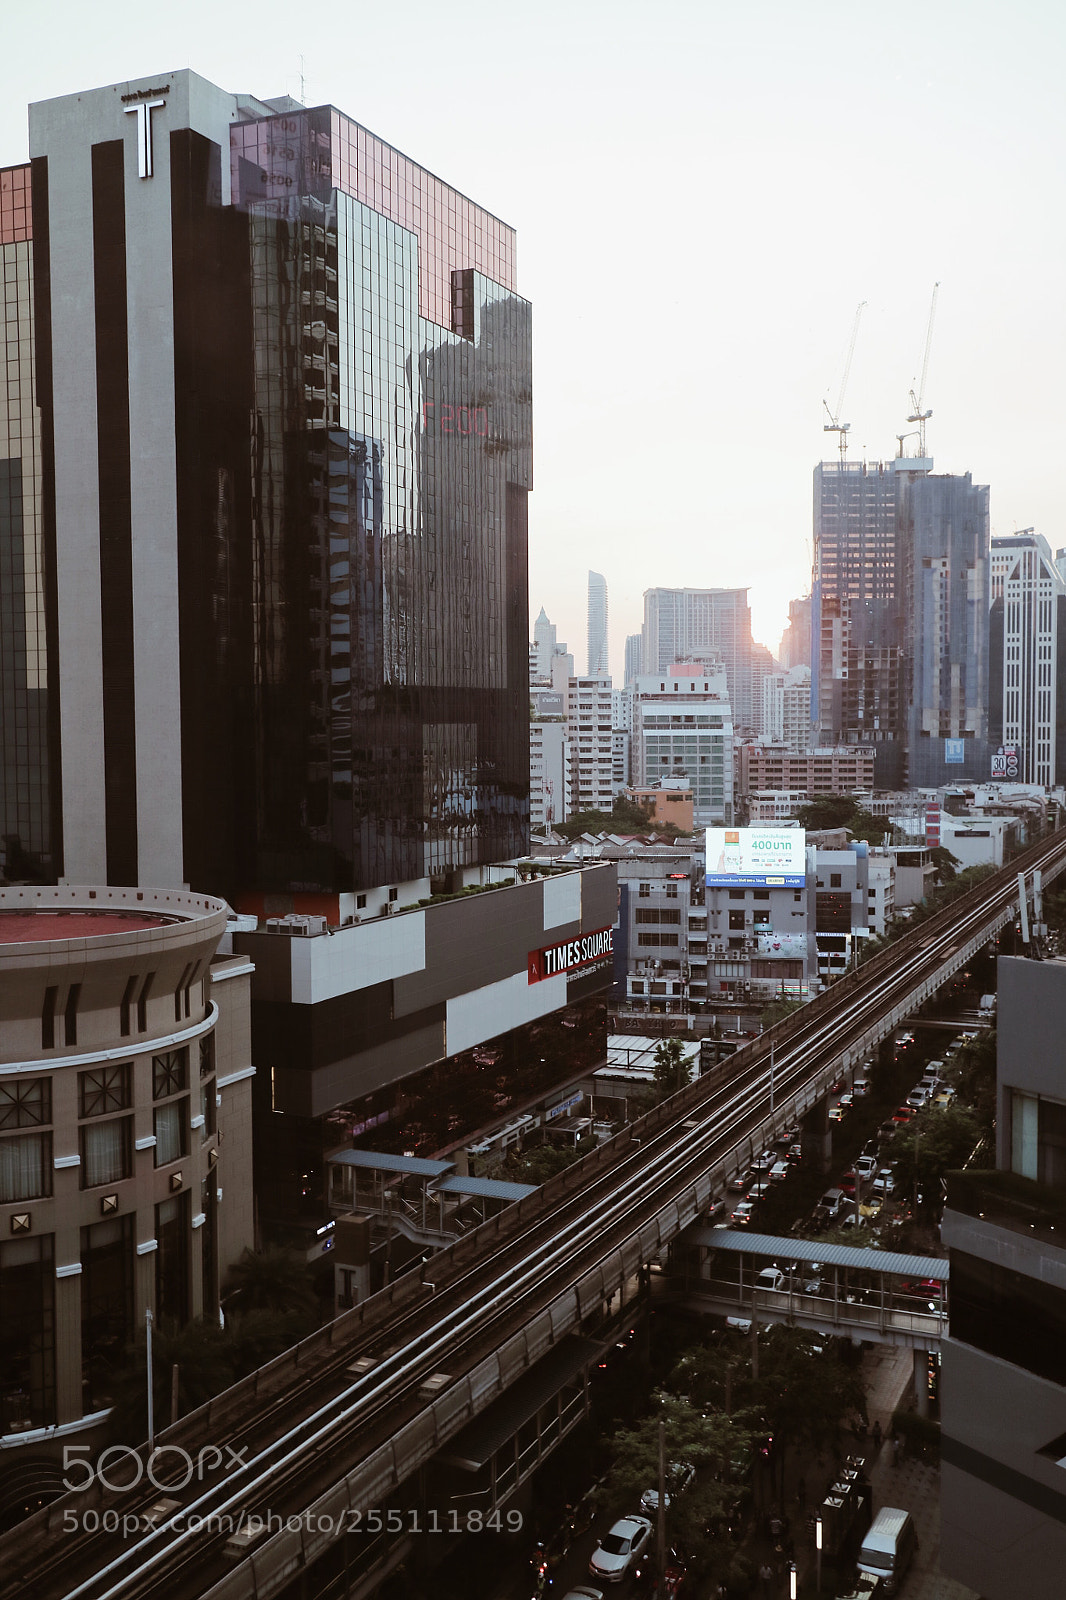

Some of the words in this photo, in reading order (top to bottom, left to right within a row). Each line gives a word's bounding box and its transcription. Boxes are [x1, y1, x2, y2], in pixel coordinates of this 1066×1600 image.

[751, 840, 772, 850] 400
[545, 940, 580, 975] TIMES
[581, 928, 615, 961] SQUARE
